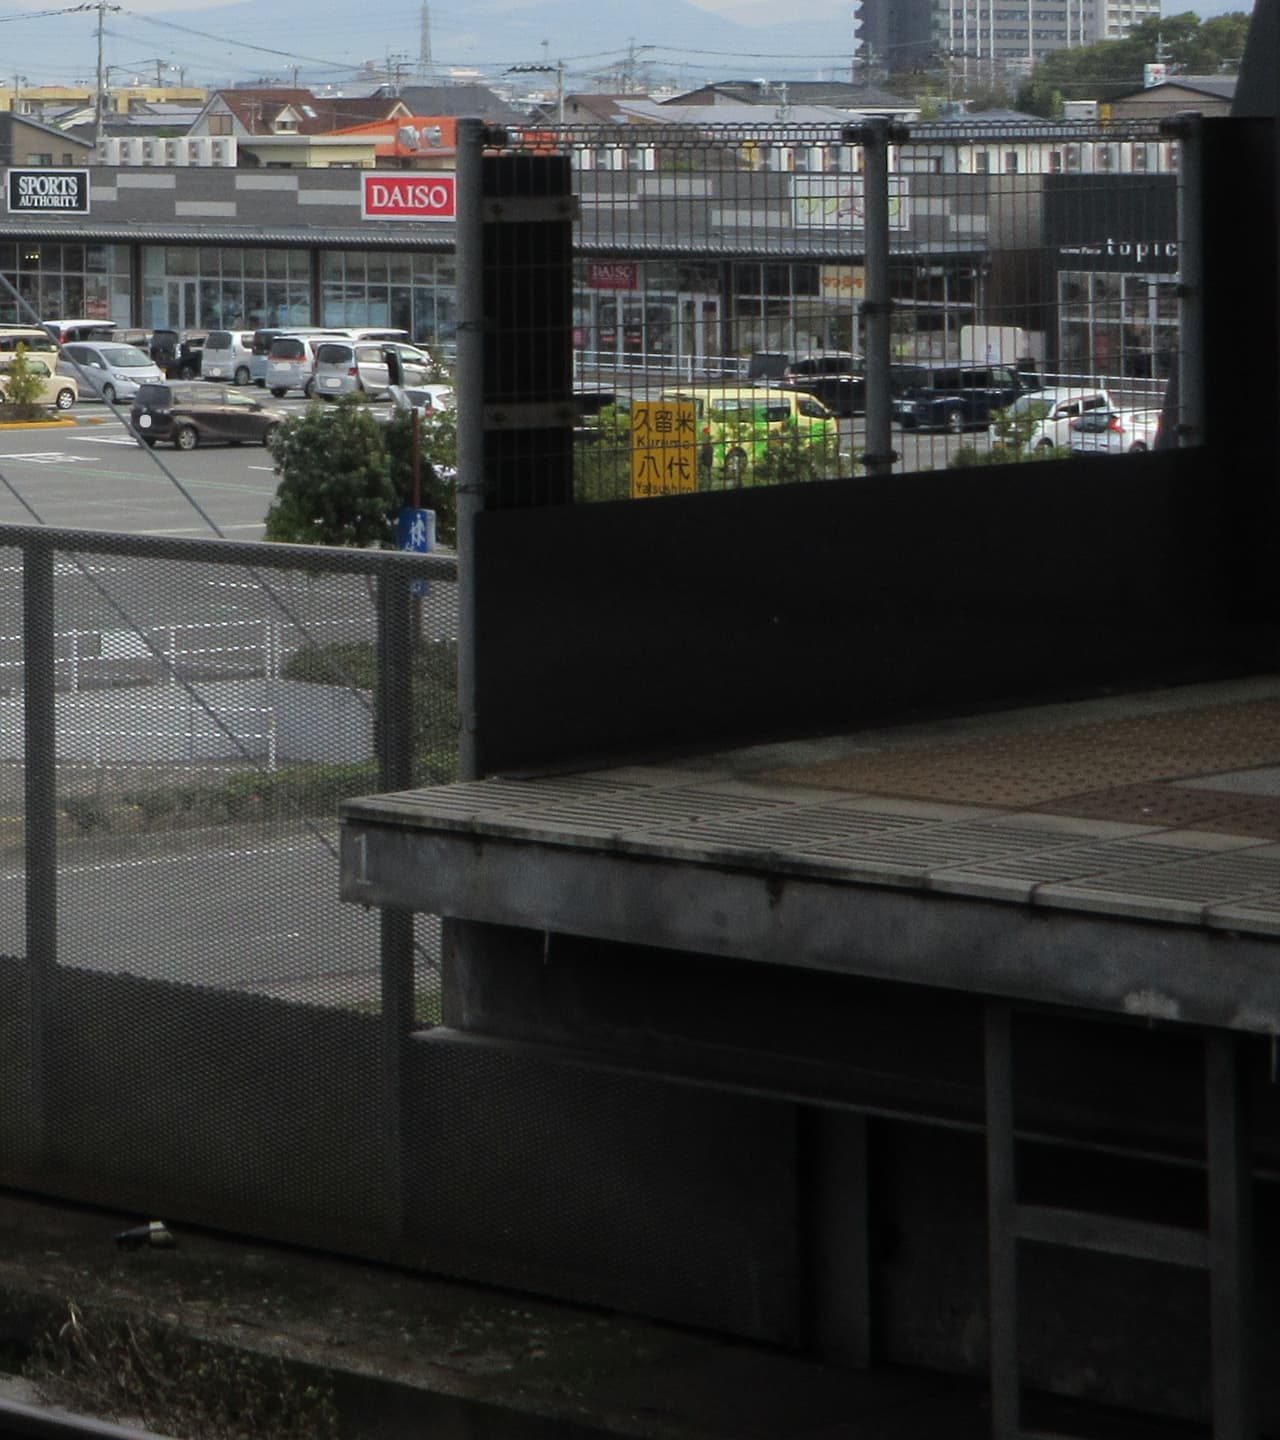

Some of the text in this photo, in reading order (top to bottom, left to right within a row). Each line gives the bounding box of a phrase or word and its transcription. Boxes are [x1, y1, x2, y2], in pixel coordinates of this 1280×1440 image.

[19, 176, 78, 195] SPORTS
[371, 185, 448, 208] DAISO
[633, 409, 694, 433] 久留米
[638, 456, 691, 479] 八代
